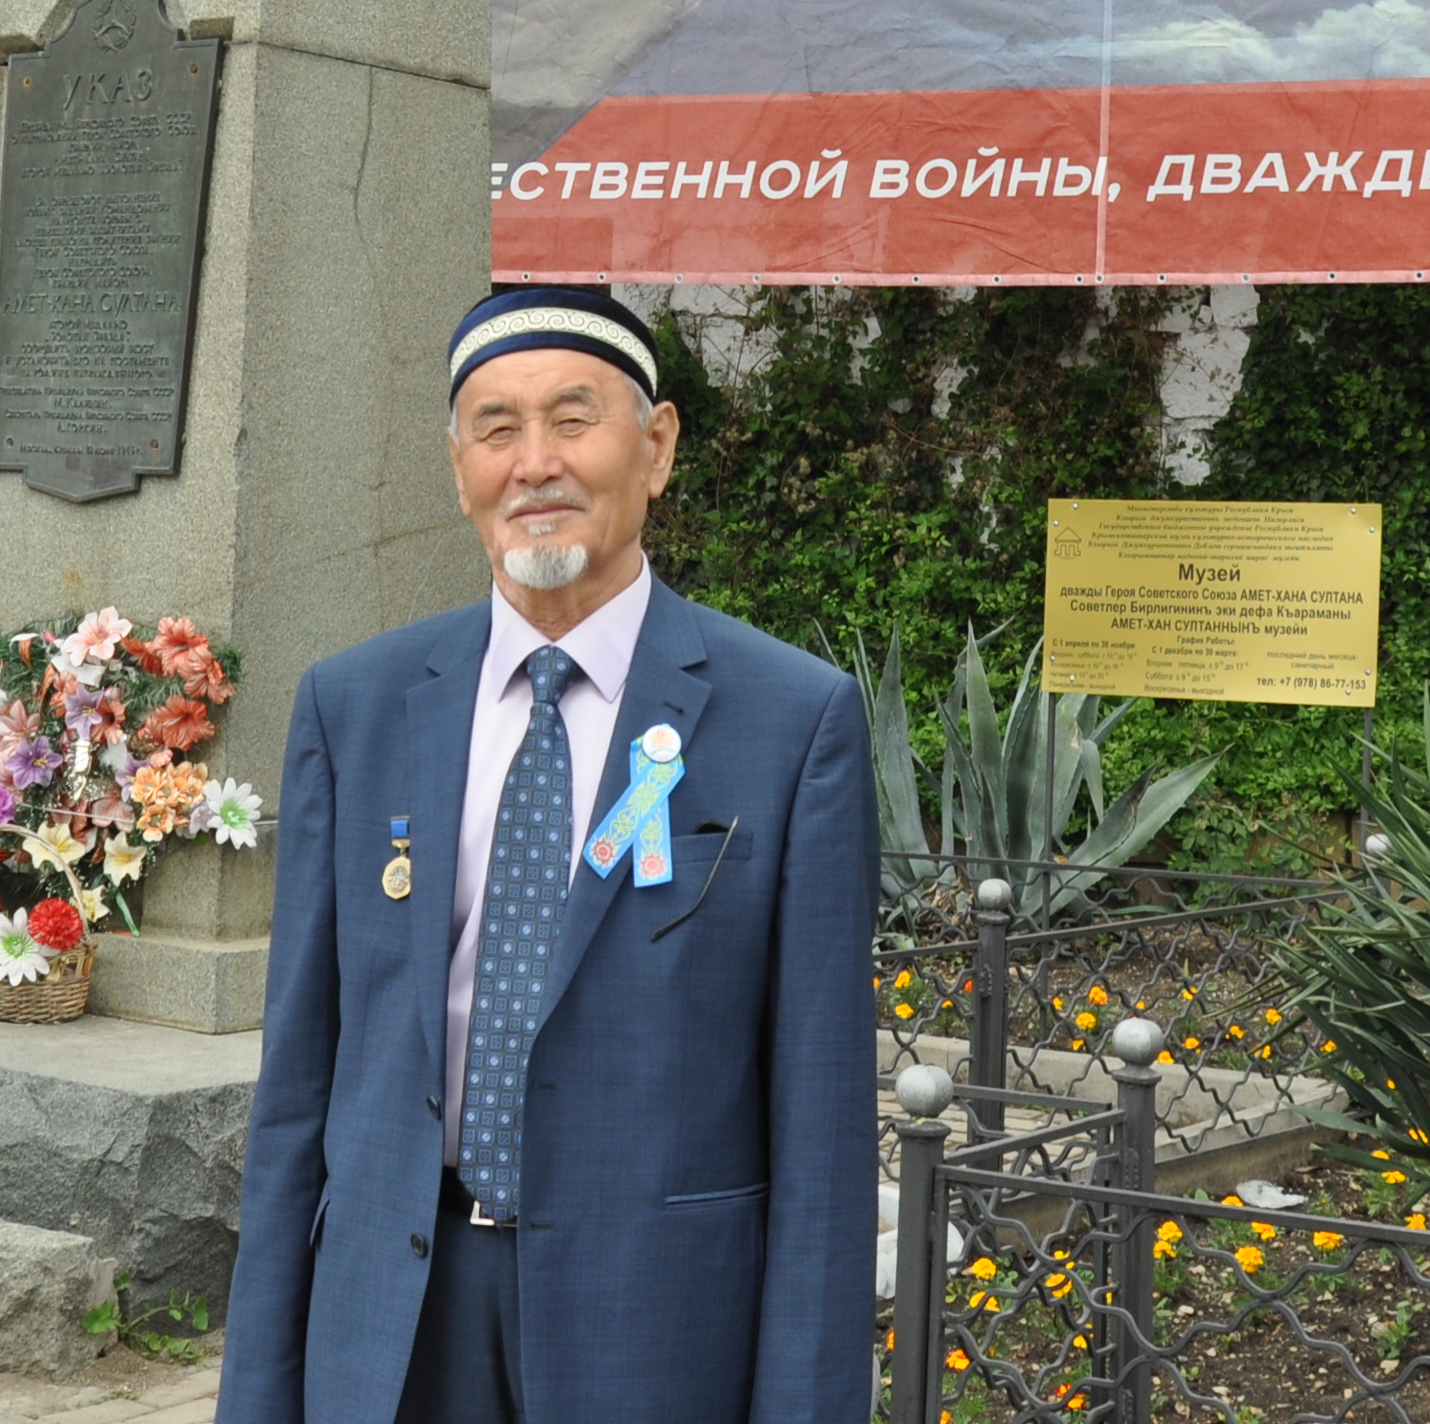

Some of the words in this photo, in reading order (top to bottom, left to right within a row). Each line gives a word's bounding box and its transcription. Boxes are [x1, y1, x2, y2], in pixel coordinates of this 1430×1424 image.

[62, 69, 153, 110] УКАЗ
[870, 146, 1120, 203] ВОЙНЫ,
[100, 291, 180, 317] СУЛТАНА
[1178, 563, 1241, 585] Музей
[1060, 586, 1102, 598] дважды
[1105, 585, 1135, 600] Героя
[1139, 586, 1199, 600] Советского
[1201, 588, 1237, 600] Союза
[1240, 589, 1307, 602] АМЕТ-ХАНА
[1310, 590, 1364, 604] СУЛТАНА
[1070, 599, 1126, 615] Советлер
[1130, 601, 1212, 616] Бирлигининъ
[1215, 607, 1236, 616] эки
[1239, 604, 1273, 619] дефа
[1277, 605, 1351, 620] Къараманы
[1111, 618, 1171, 630] АМЕТ-ХАН
[1174, 619, 1260, 634] СУЛТАННЫНЪ
[1264, 624, 1308, 637] музейи
[1257, 677, 1277, 686] тел:
[1280, 676, 1291, 686] +7
[1294, 677, 1317, 690] (978)
[1320, 678, 1366, 690] 86-77-153
